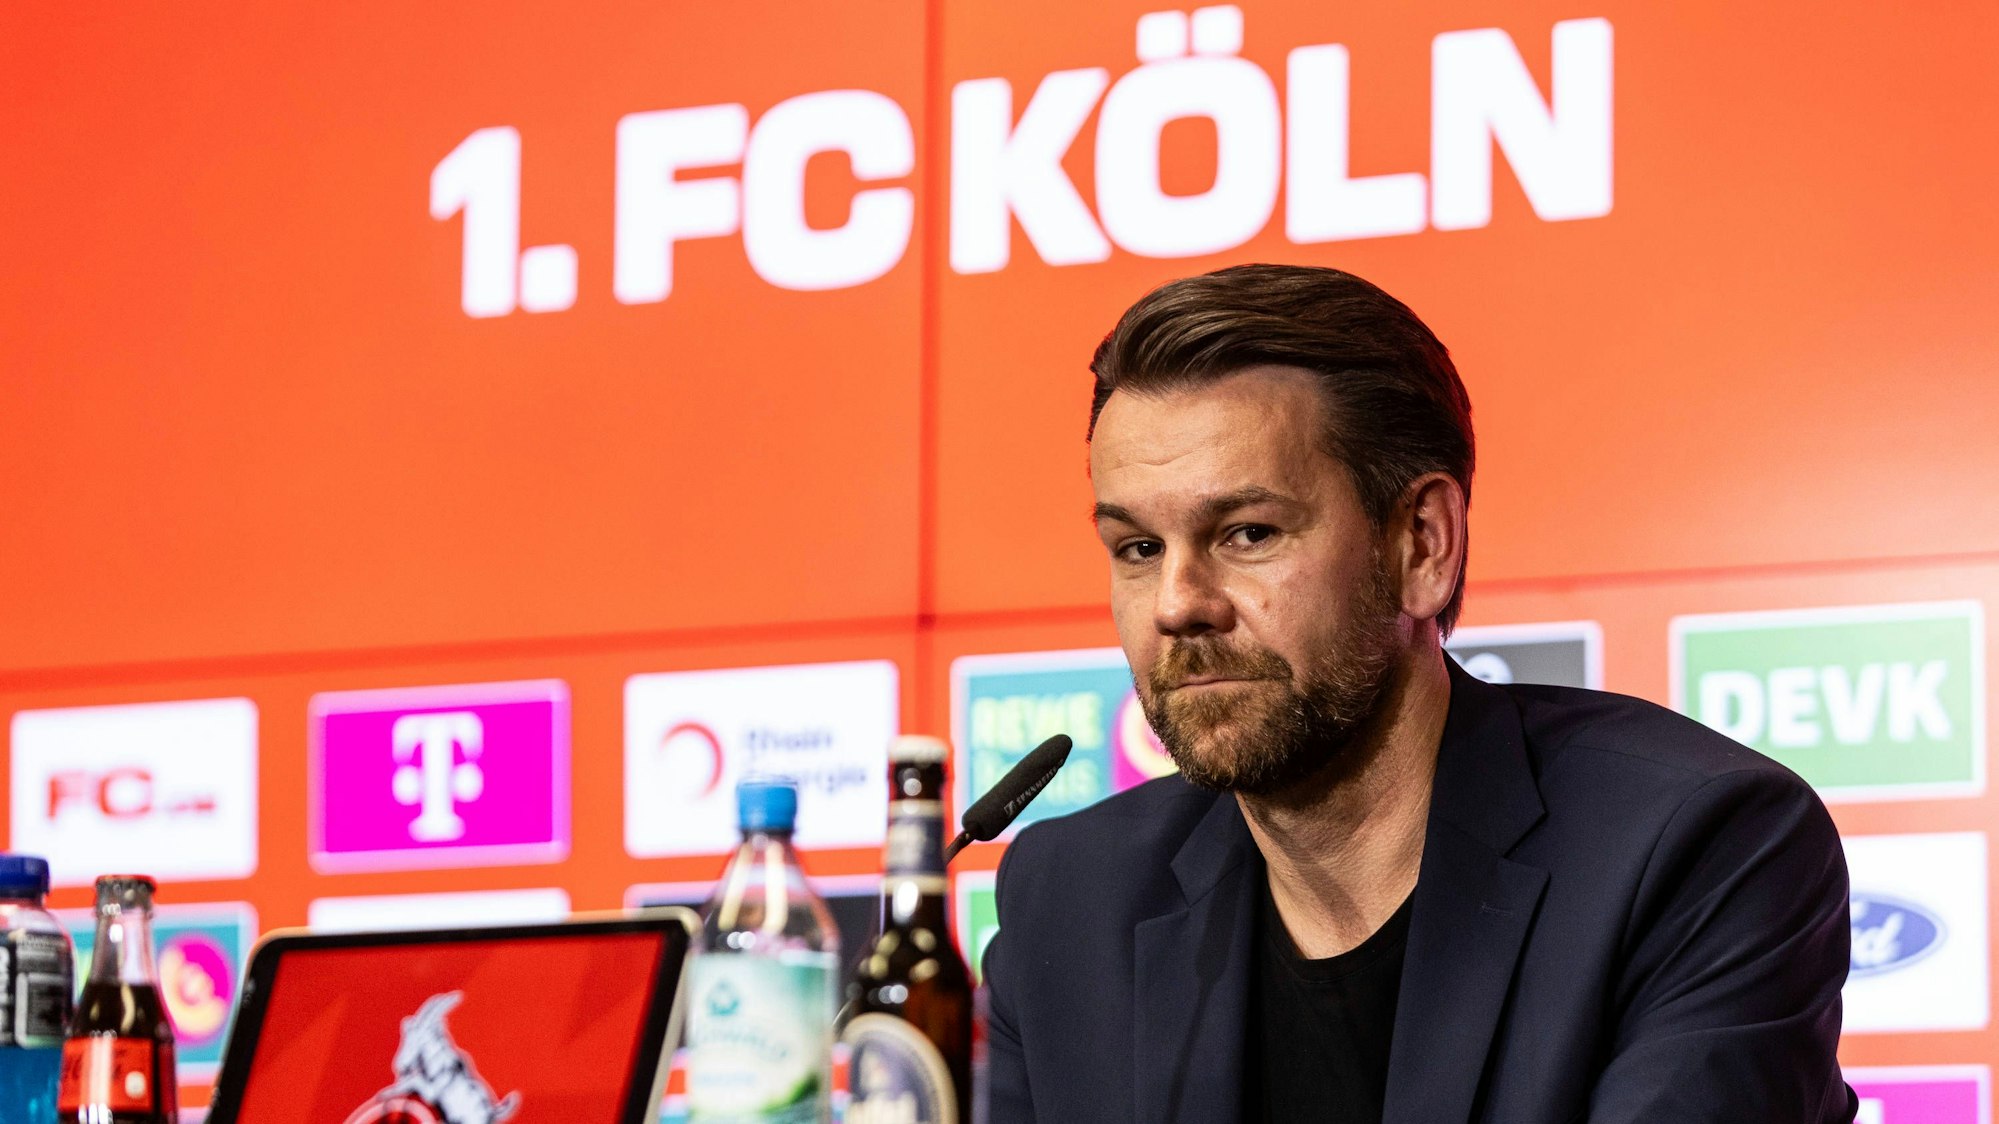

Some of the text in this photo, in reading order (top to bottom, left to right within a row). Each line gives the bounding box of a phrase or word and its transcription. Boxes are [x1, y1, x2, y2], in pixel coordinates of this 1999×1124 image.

[429, 4, 1615, 318] 1. FC KÖLN
[971, 691, 1104, 752] REWE
[1698, 659, 1952, 748] DEVK
